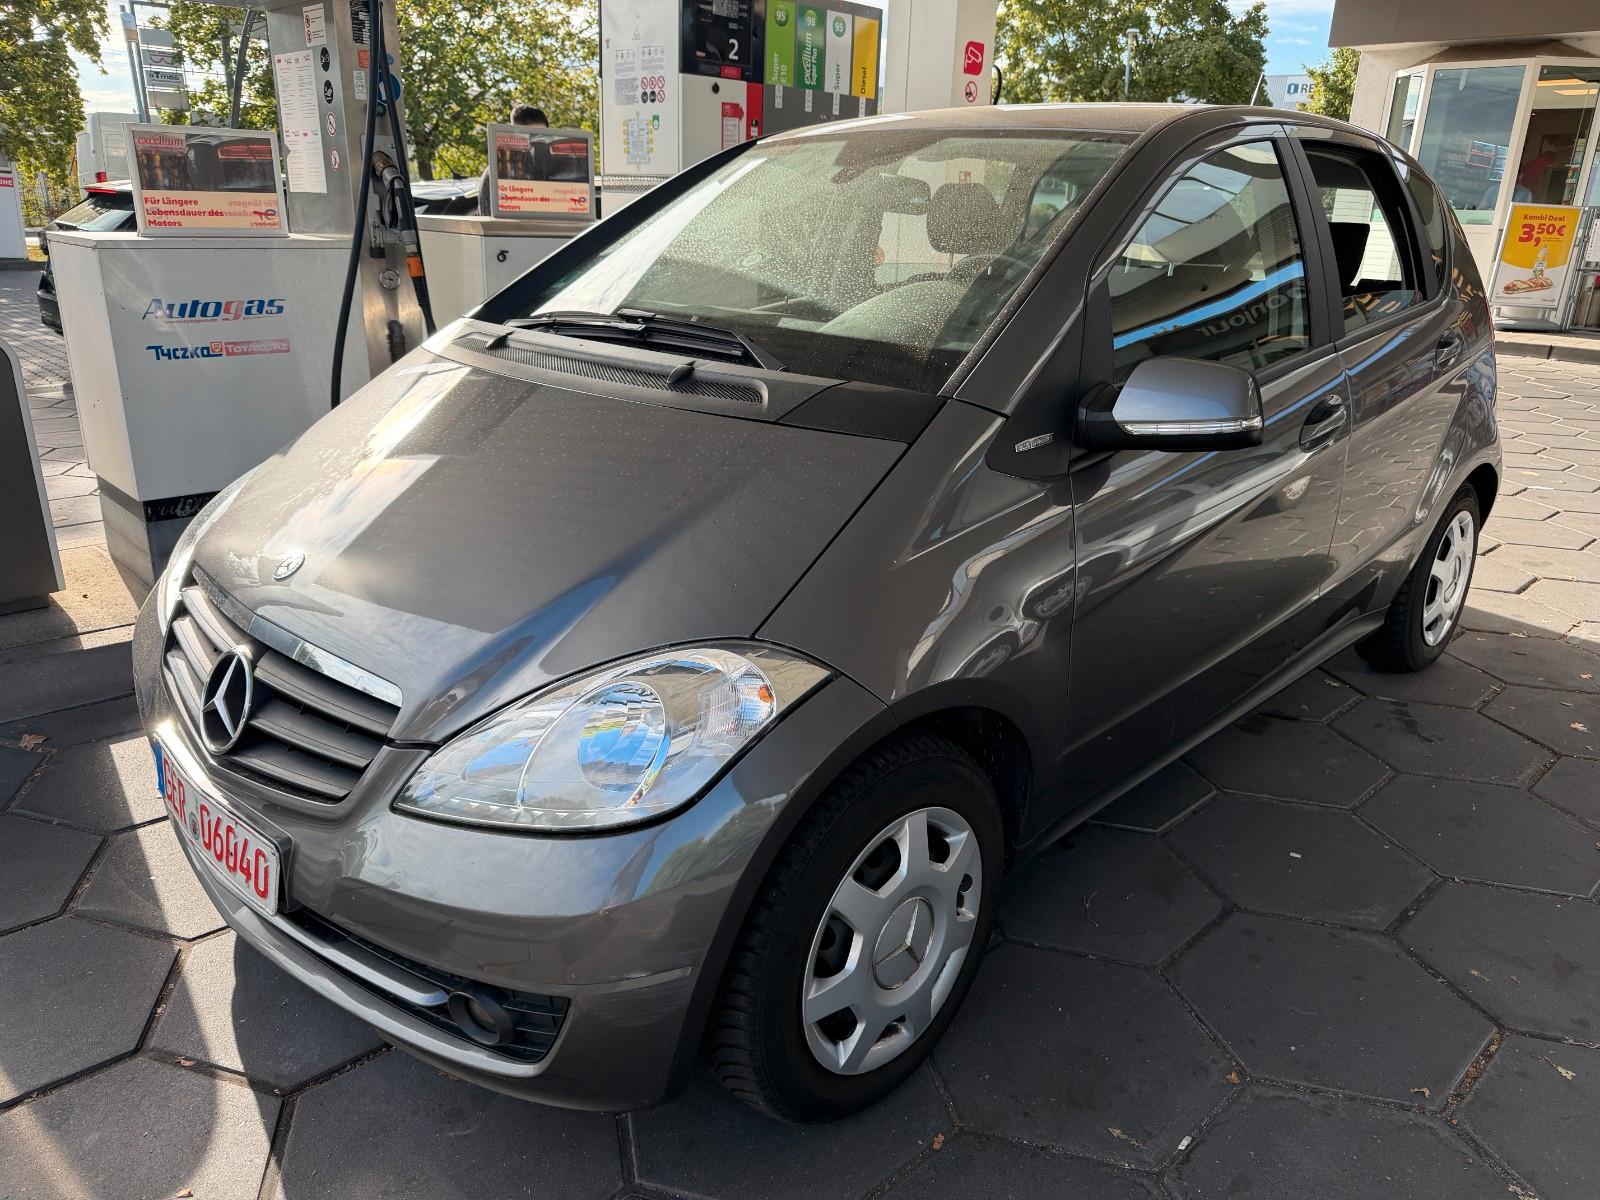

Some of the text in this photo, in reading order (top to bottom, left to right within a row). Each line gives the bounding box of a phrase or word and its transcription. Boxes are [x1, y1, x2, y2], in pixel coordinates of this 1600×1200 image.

[776, 10, 786, 22] 95
[834, 22, 844, 32] 95
[728, 38, 739, 61] 2
[802, 32, 813, 85] excellium
[780, 64, 788, 83] E10
[811, 64, 819, 86] Super
[137, 133, 184, 147] excellium
[144, 197, 199, 207] Für längere
[146, 208, 206, 217] Lebensdauer
[208, 208, 225, 217] des
[1523, 213, 1566, 222] Kombi Deal
[147, 218, 183, 227] Motors
[141, 298, 286, 320] Autogas
[145, 345, 221, 361] Tyczka
[163, 757, 269, 901] GER 06040
